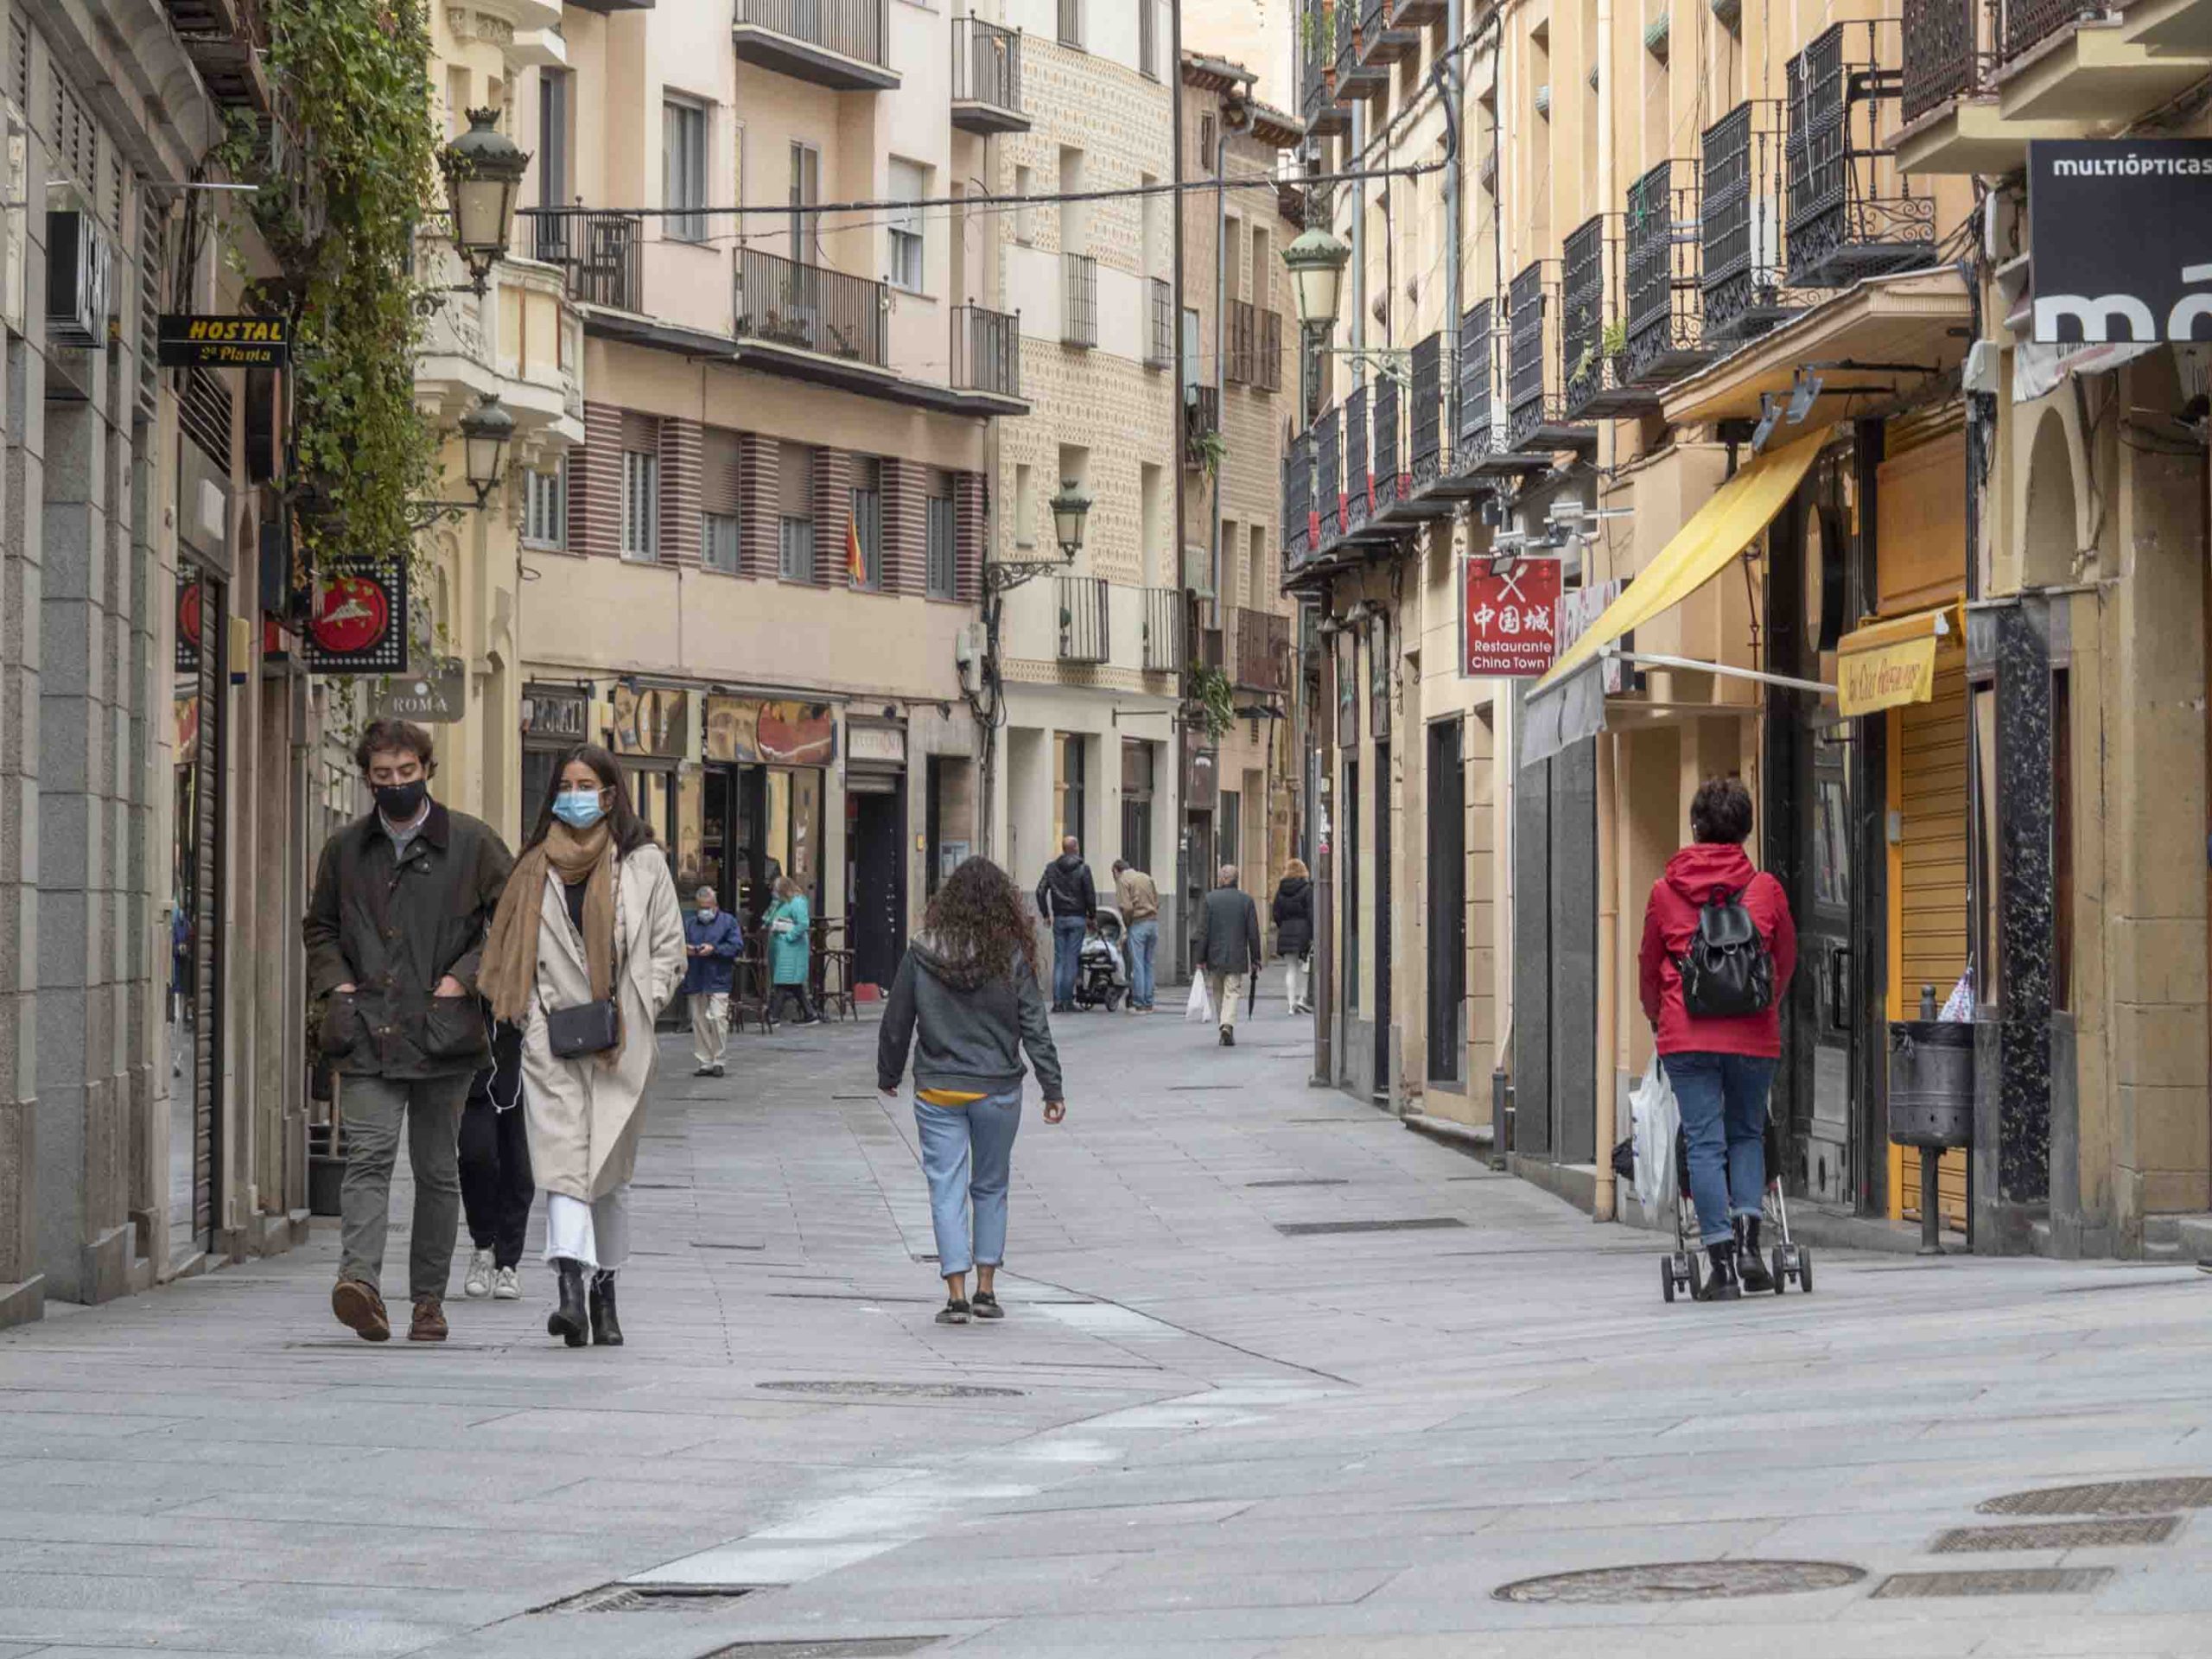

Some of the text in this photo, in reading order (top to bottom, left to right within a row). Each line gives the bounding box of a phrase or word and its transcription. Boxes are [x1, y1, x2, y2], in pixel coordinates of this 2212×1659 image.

[188, 321, 282, 340] HOSTAL
[219, 346, 271, 362] Planta
[1472, 602, 1554, 638] 中国城
[1474, 640, 1552, 653] Restaurante
[1471, 656, 1510, 669] China
[1513, 657, 1545, 669] Town
[393, 697, 448, 712] ROMA
